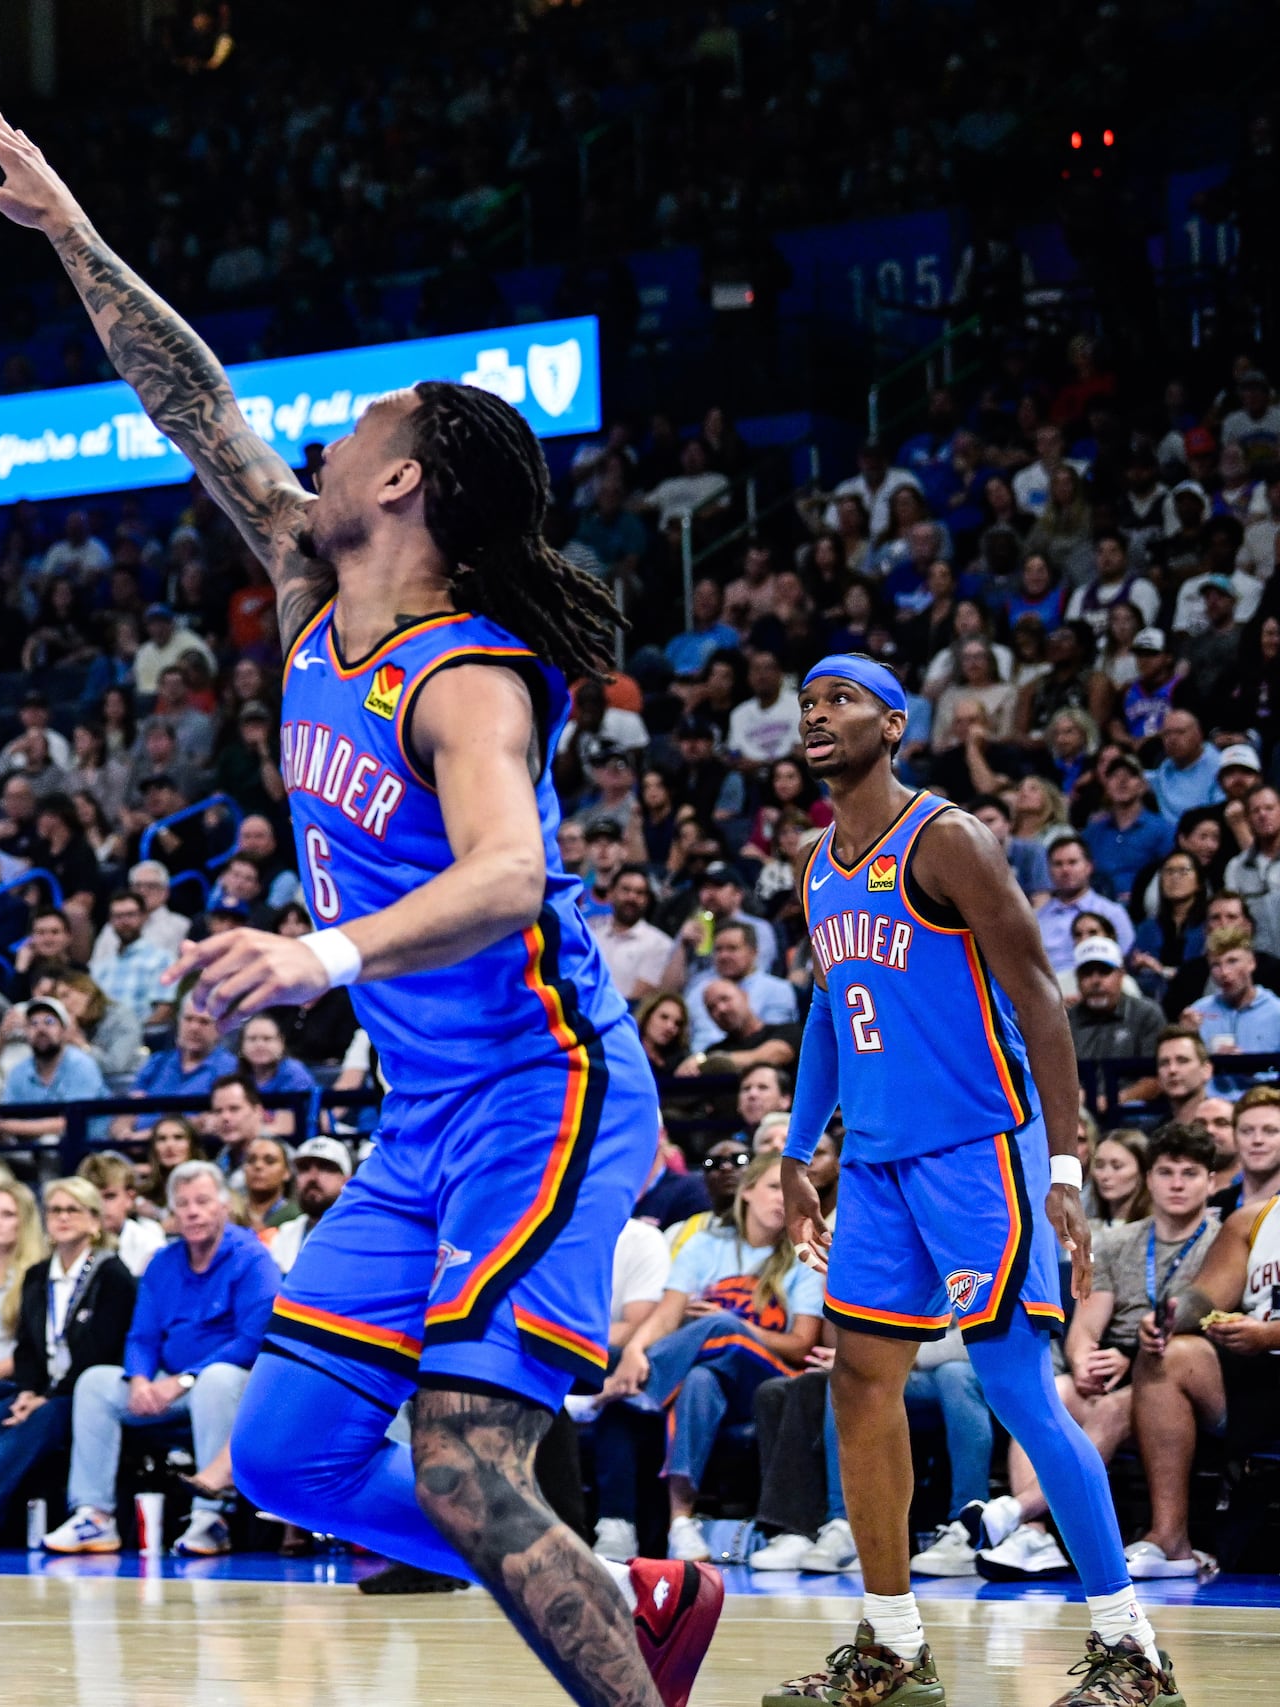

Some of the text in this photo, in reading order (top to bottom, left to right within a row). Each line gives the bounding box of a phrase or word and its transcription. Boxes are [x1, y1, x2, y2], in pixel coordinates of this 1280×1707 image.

[847, 254, 943, 322] 105
[78, 422, 112, 457] at
[111, 412, 167, 462] THE
[274, 393, 311, 442] of
[310, 389, 353, 428] all
[280, 720, 407, 842] HUNDER
[304, 823, 341, 922] 6
[845, 983, 884, 1055] 2
